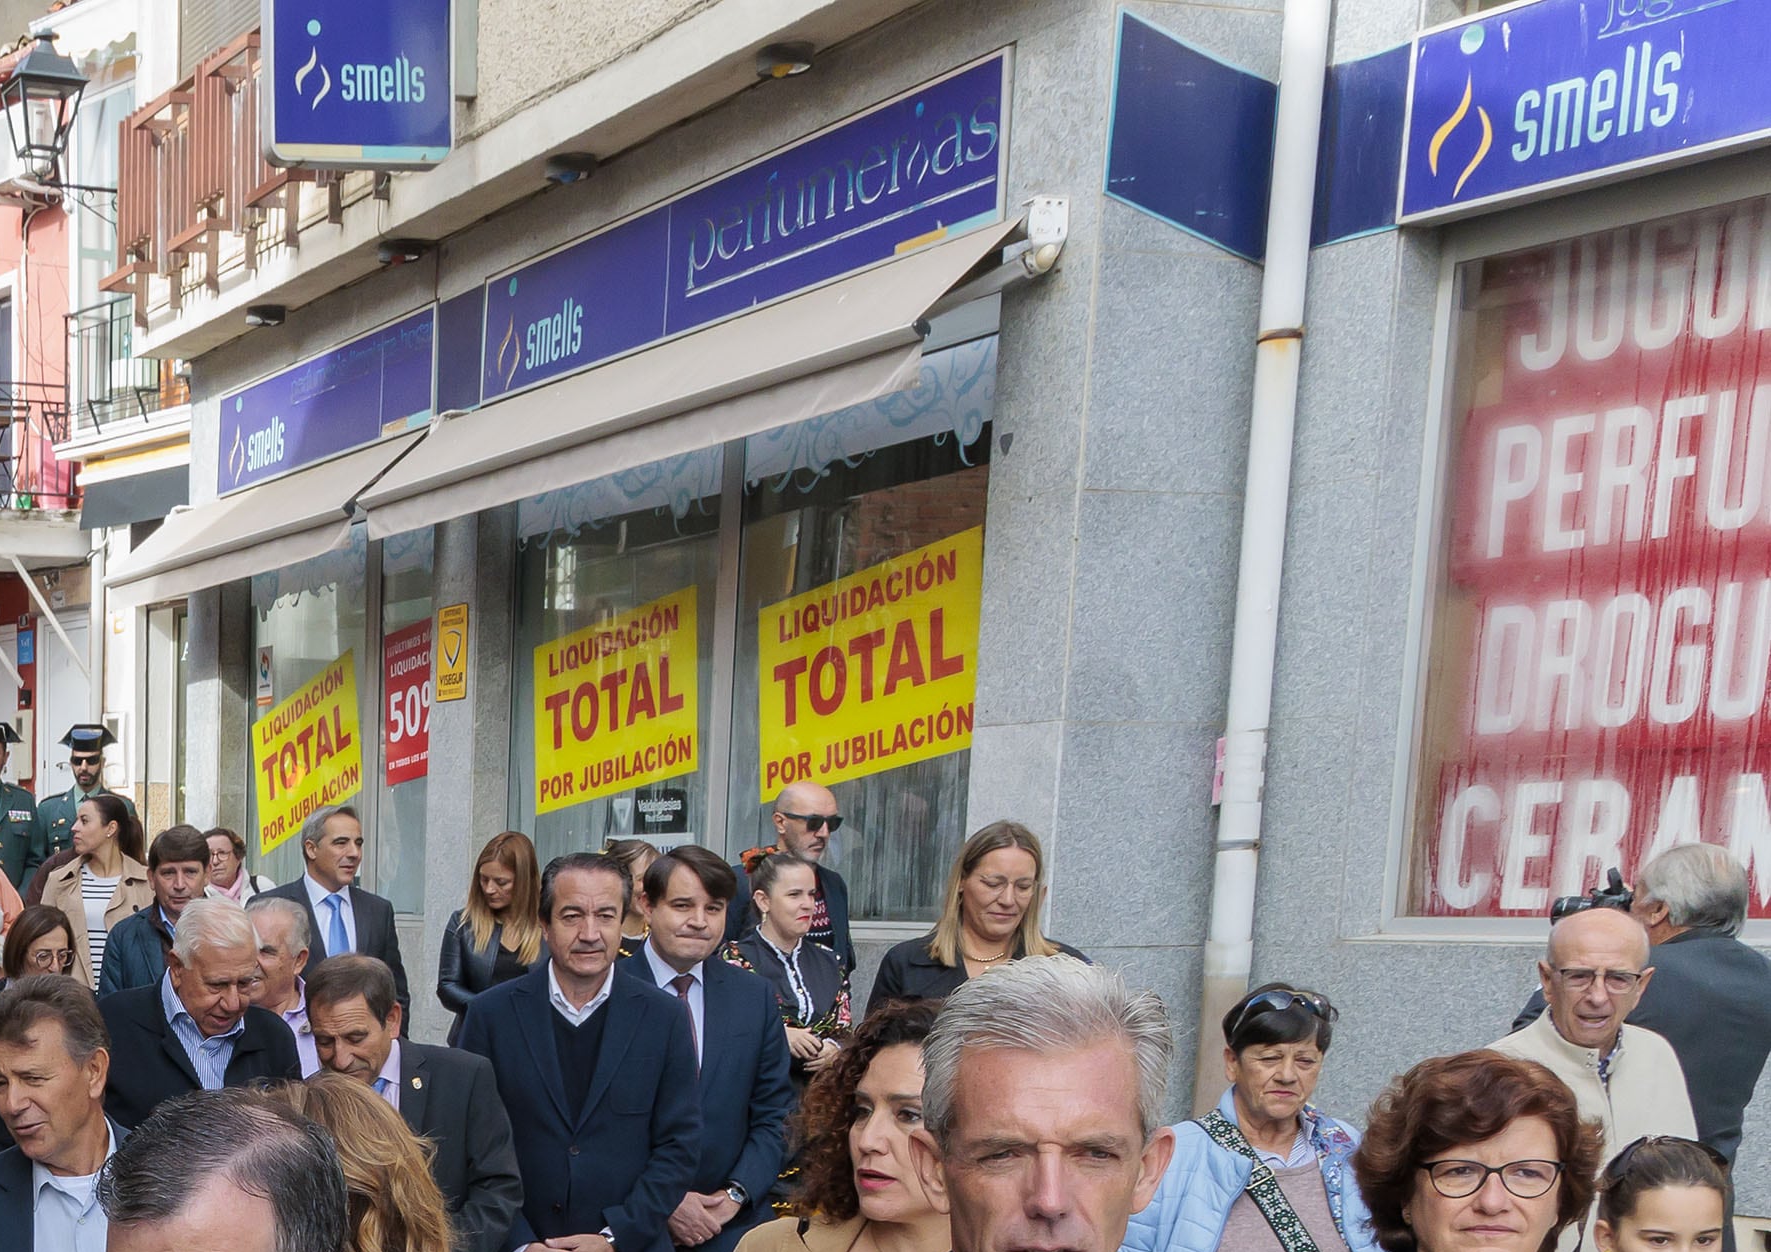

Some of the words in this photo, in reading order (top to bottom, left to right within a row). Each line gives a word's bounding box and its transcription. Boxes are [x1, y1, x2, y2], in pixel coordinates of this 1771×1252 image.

[341, 56, 425, 103] smells
[1511, 41, 1681, 162] smells
[1520, 198, 1771, 372] JUGU
[525, 297, 583, 370] smells
[246, 415, 285, 472] smells
[1486, 384, 1771, 559] PERFU
[779, 549, 958, 644] LIQUIDACIÓN
[390, 650, 431, 678] LIQUIDACI
[548, 604, 680, 679] LIQUIDACIÓN
[773, 607, 965, 728] TOTAL
[1478, 579, 1771, 735] DROGU
[262, 664, 344, 745] LIQUIDACIÓN
[545, 654, 684, 751] TOTAL
[766, 751, 813, 790] POR
[819, 702, 975, 775] JUBILACIÓN
[261, 704, 352, 801] TOTAL
[540, 772, 574, 804] POR
[579, 733, 693, 792] JUBILACIÓN
[262, 817, 285, 847] POR
[288, 762, 360, 829] JUBILACIÓN
